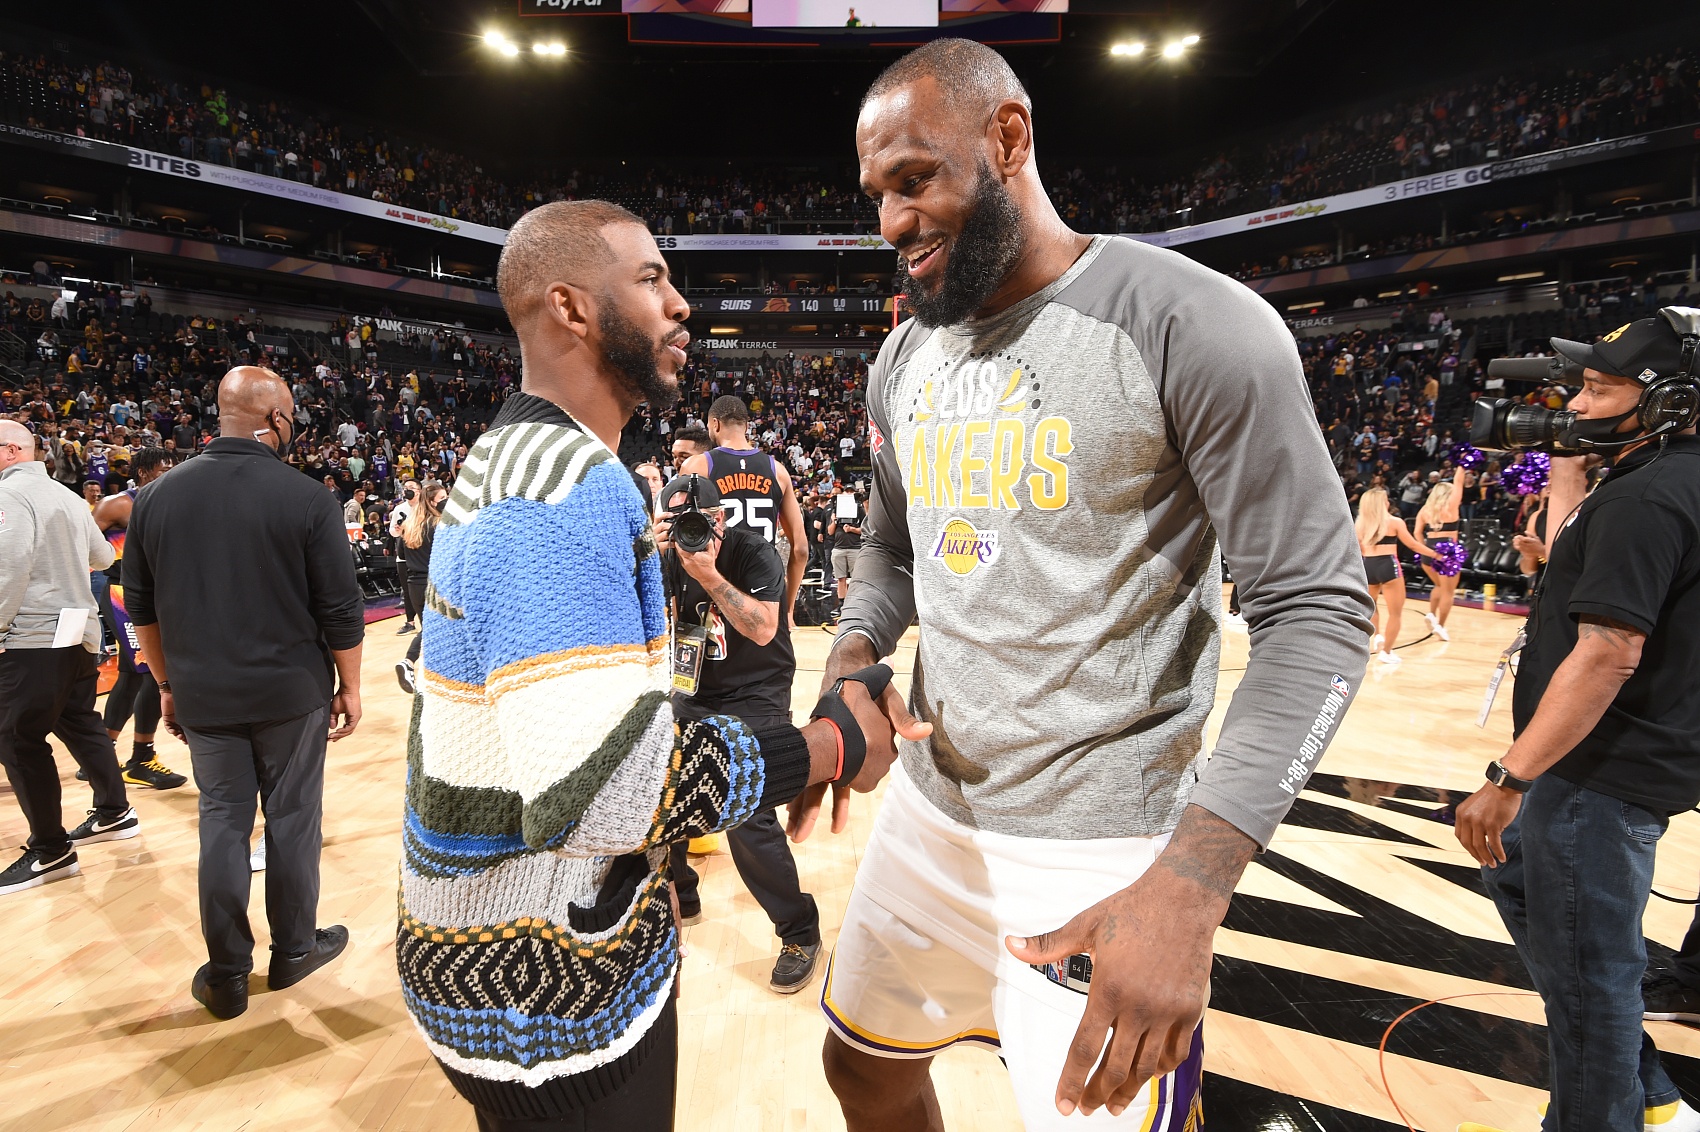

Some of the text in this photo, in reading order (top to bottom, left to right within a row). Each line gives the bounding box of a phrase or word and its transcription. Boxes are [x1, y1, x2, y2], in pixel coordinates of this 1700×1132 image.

[9, 127, 61, 143] TONIGHT'S
[128, 151, 201, 178] BITES
[1512, 152, 1564, 169] ATTENDING
[1525, 163, 1549, 175] SAFE
[210, 170, 339, 204] WITH PURCHASE OF MEDIUM FRIES
[1384, 187, 1398, 200] 3
[1403, 174, 1459, 196] FREE
[385, 208, 401, 219] ALL
[1247, 216, 1263, 226] ALL
[655, 237, 677, 248] ES
[720, 299, 752, 310] SUNS
[801, 300, 819, 312] 140
[833, 298, 846, 308] 0.0
[862, 300, 879, 312] 111
[1294, 316, 1335, 329] ERRACE
[405, 324, 438, 336] TERRA
[740, 341, 778, 349] TERRACE
[938, 361, 998, 419] LOS
[98, 466, 105, 475] 6
[716, 472, 772, 496] BRIDGES
[719, 498, 774, 544] 25
[933, 531, 995, 564] LAKERS
[123, 622, 141, 649] SUNS
[1311, 689, 1345, 739] Noches
[1072, 964, 1081, 973] 54
